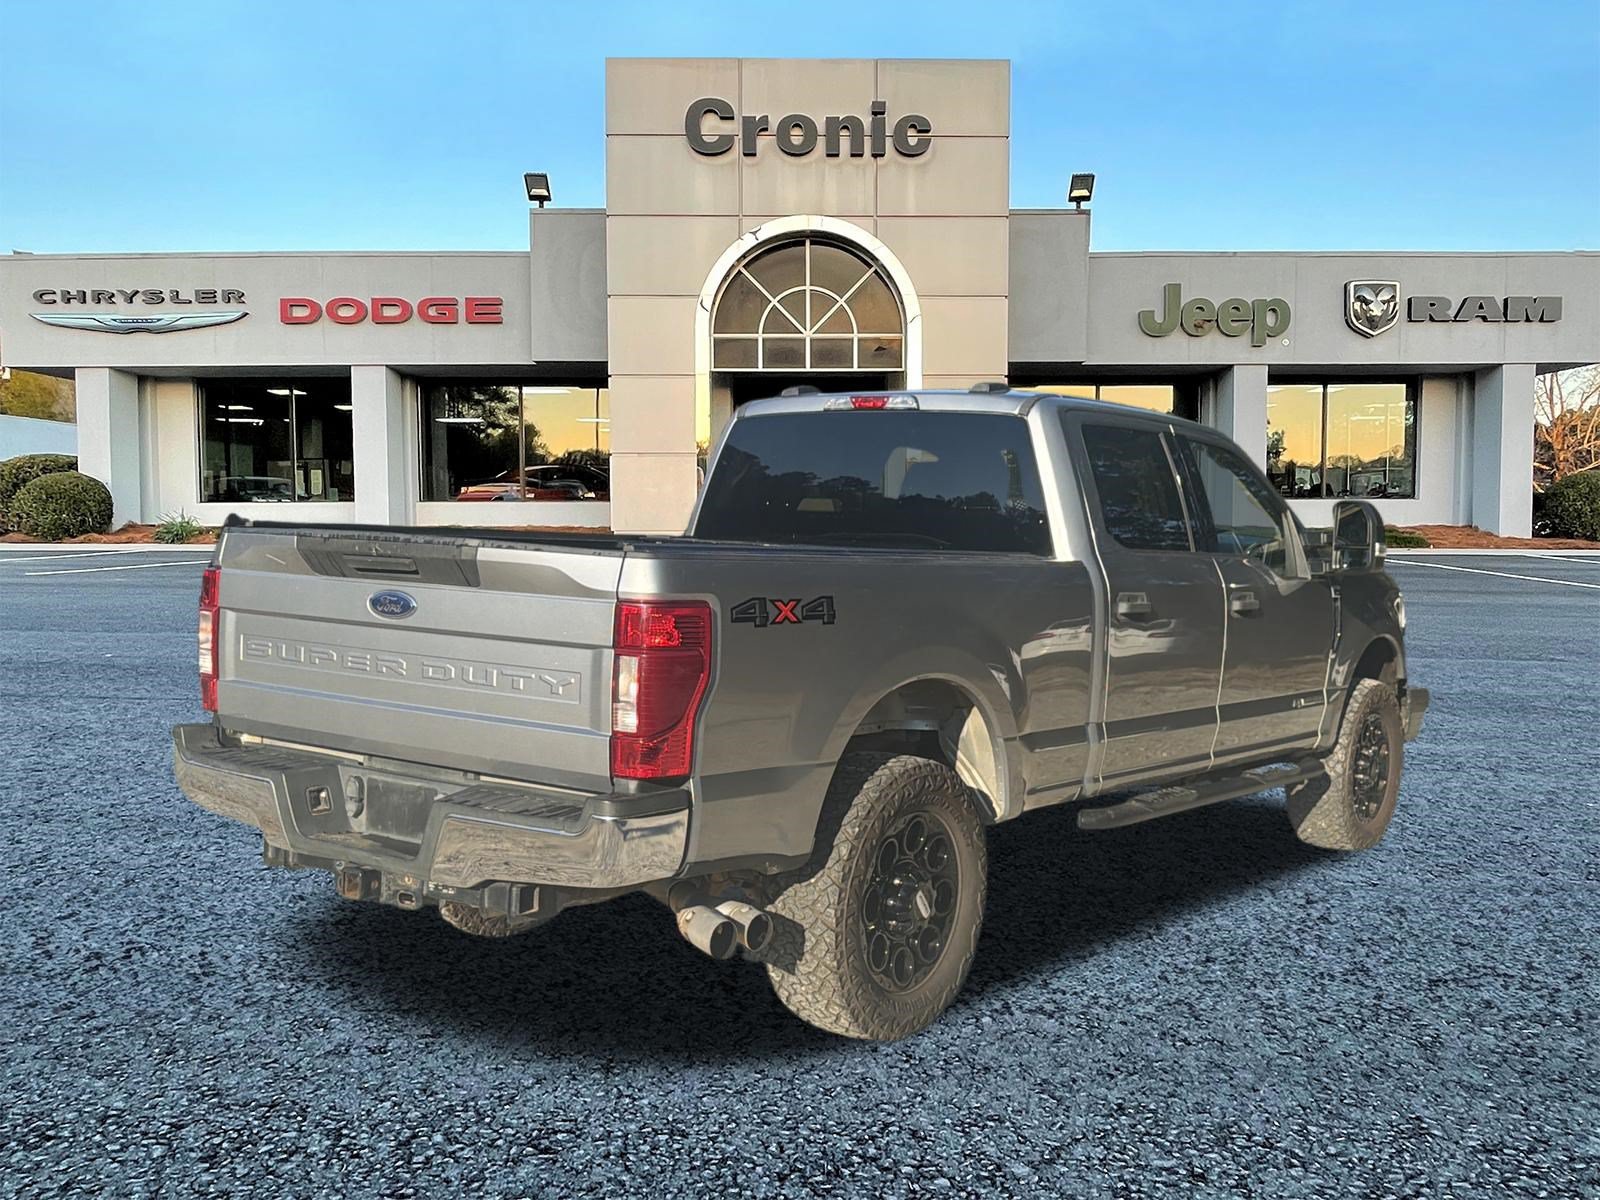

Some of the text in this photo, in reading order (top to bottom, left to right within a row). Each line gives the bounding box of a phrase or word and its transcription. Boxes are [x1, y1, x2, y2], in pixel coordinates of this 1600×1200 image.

[685, 97, 932, 157] Cronic
[32, 288, 247, 305] CHRYSLER
[1407, 296, 1562, 322] RAM
[279, 297, 503, 324] DODGE
[1138, 283, 1291, 347] Jeep
[377, 595, 405, 613] Ford
[246, 640, 577, 696] SUPER DUTY
